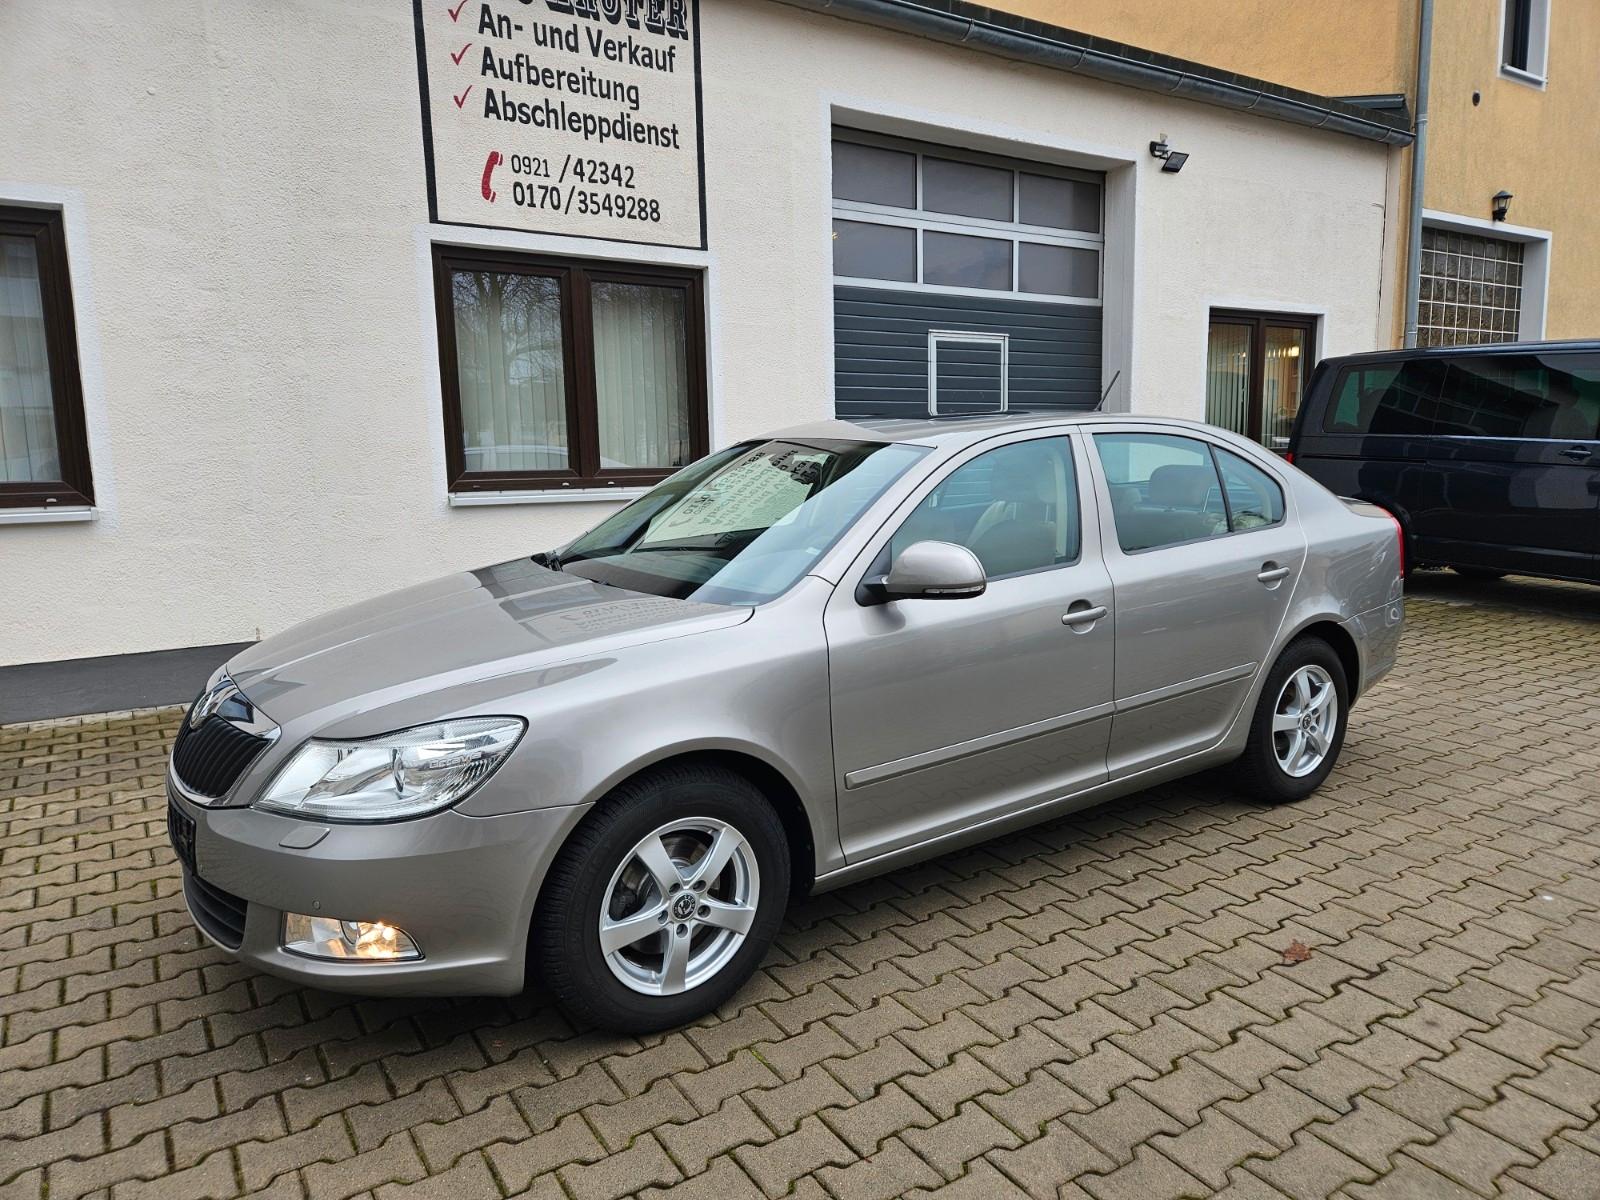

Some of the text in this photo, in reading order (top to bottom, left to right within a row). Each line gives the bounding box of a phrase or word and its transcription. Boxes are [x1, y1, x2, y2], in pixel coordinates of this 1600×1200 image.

[478, 3, 523, 40] An-
[533, 21, 579, 54] und
[586, 26, 676, 73] Verkauf
[481, 46, 640, 110] Aufbereitung
[484, 87, 680, 149] Abschleppdienst
[511, 154, 551, 178] 0921
